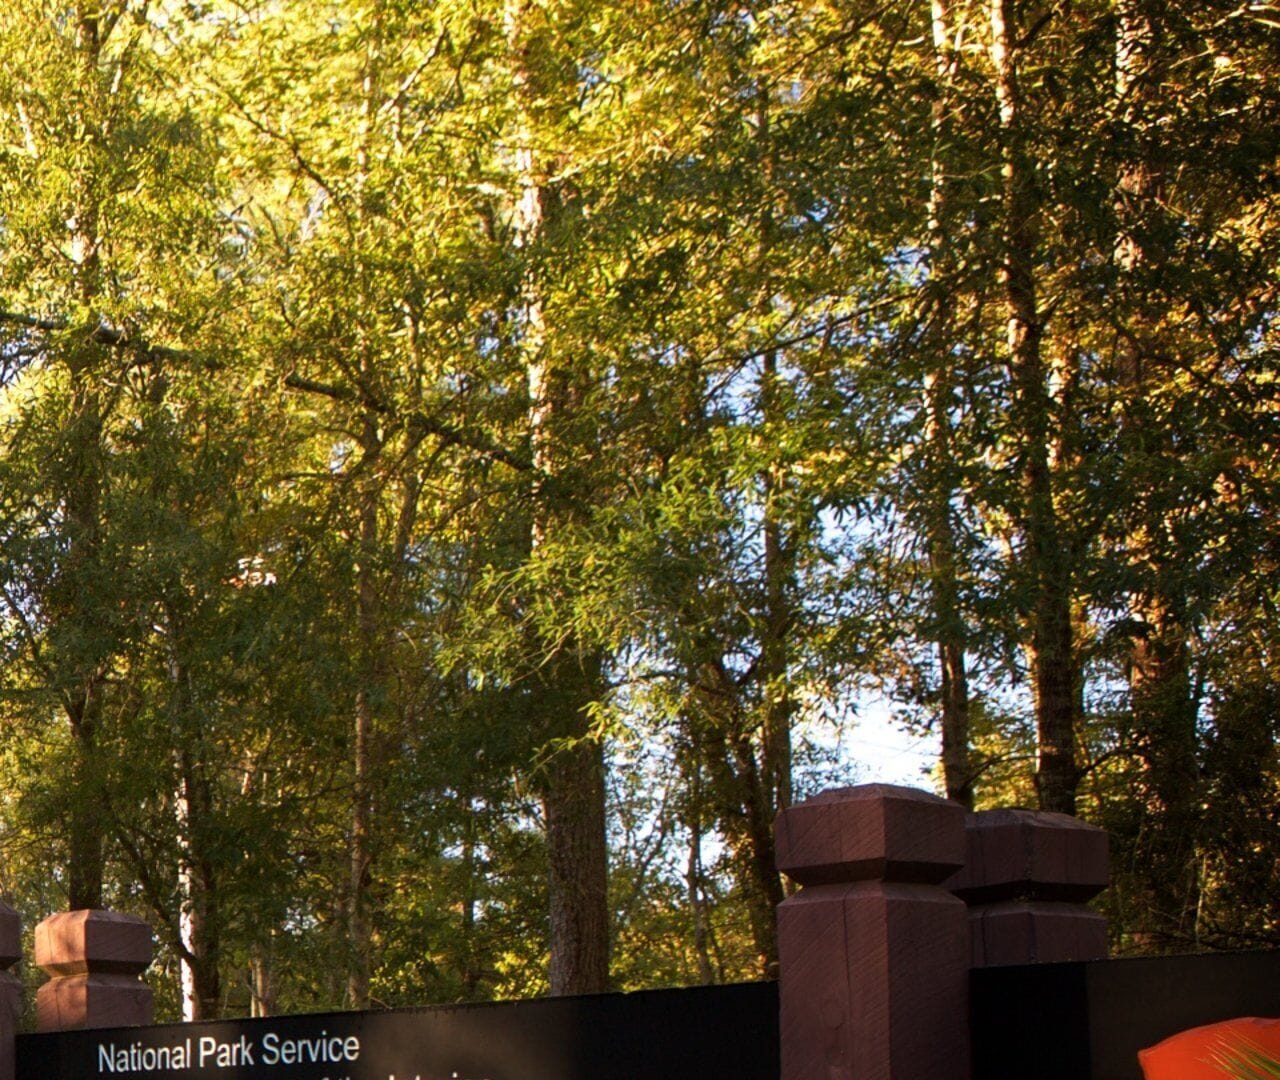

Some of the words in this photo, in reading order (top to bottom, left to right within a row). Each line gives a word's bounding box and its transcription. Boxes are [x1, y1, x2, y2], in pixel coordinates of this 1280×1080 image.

[98, 1039, 191, 1073] National
[199, 1035, 255, 1068] Park
[262, 1030, 360, 1066] Service
